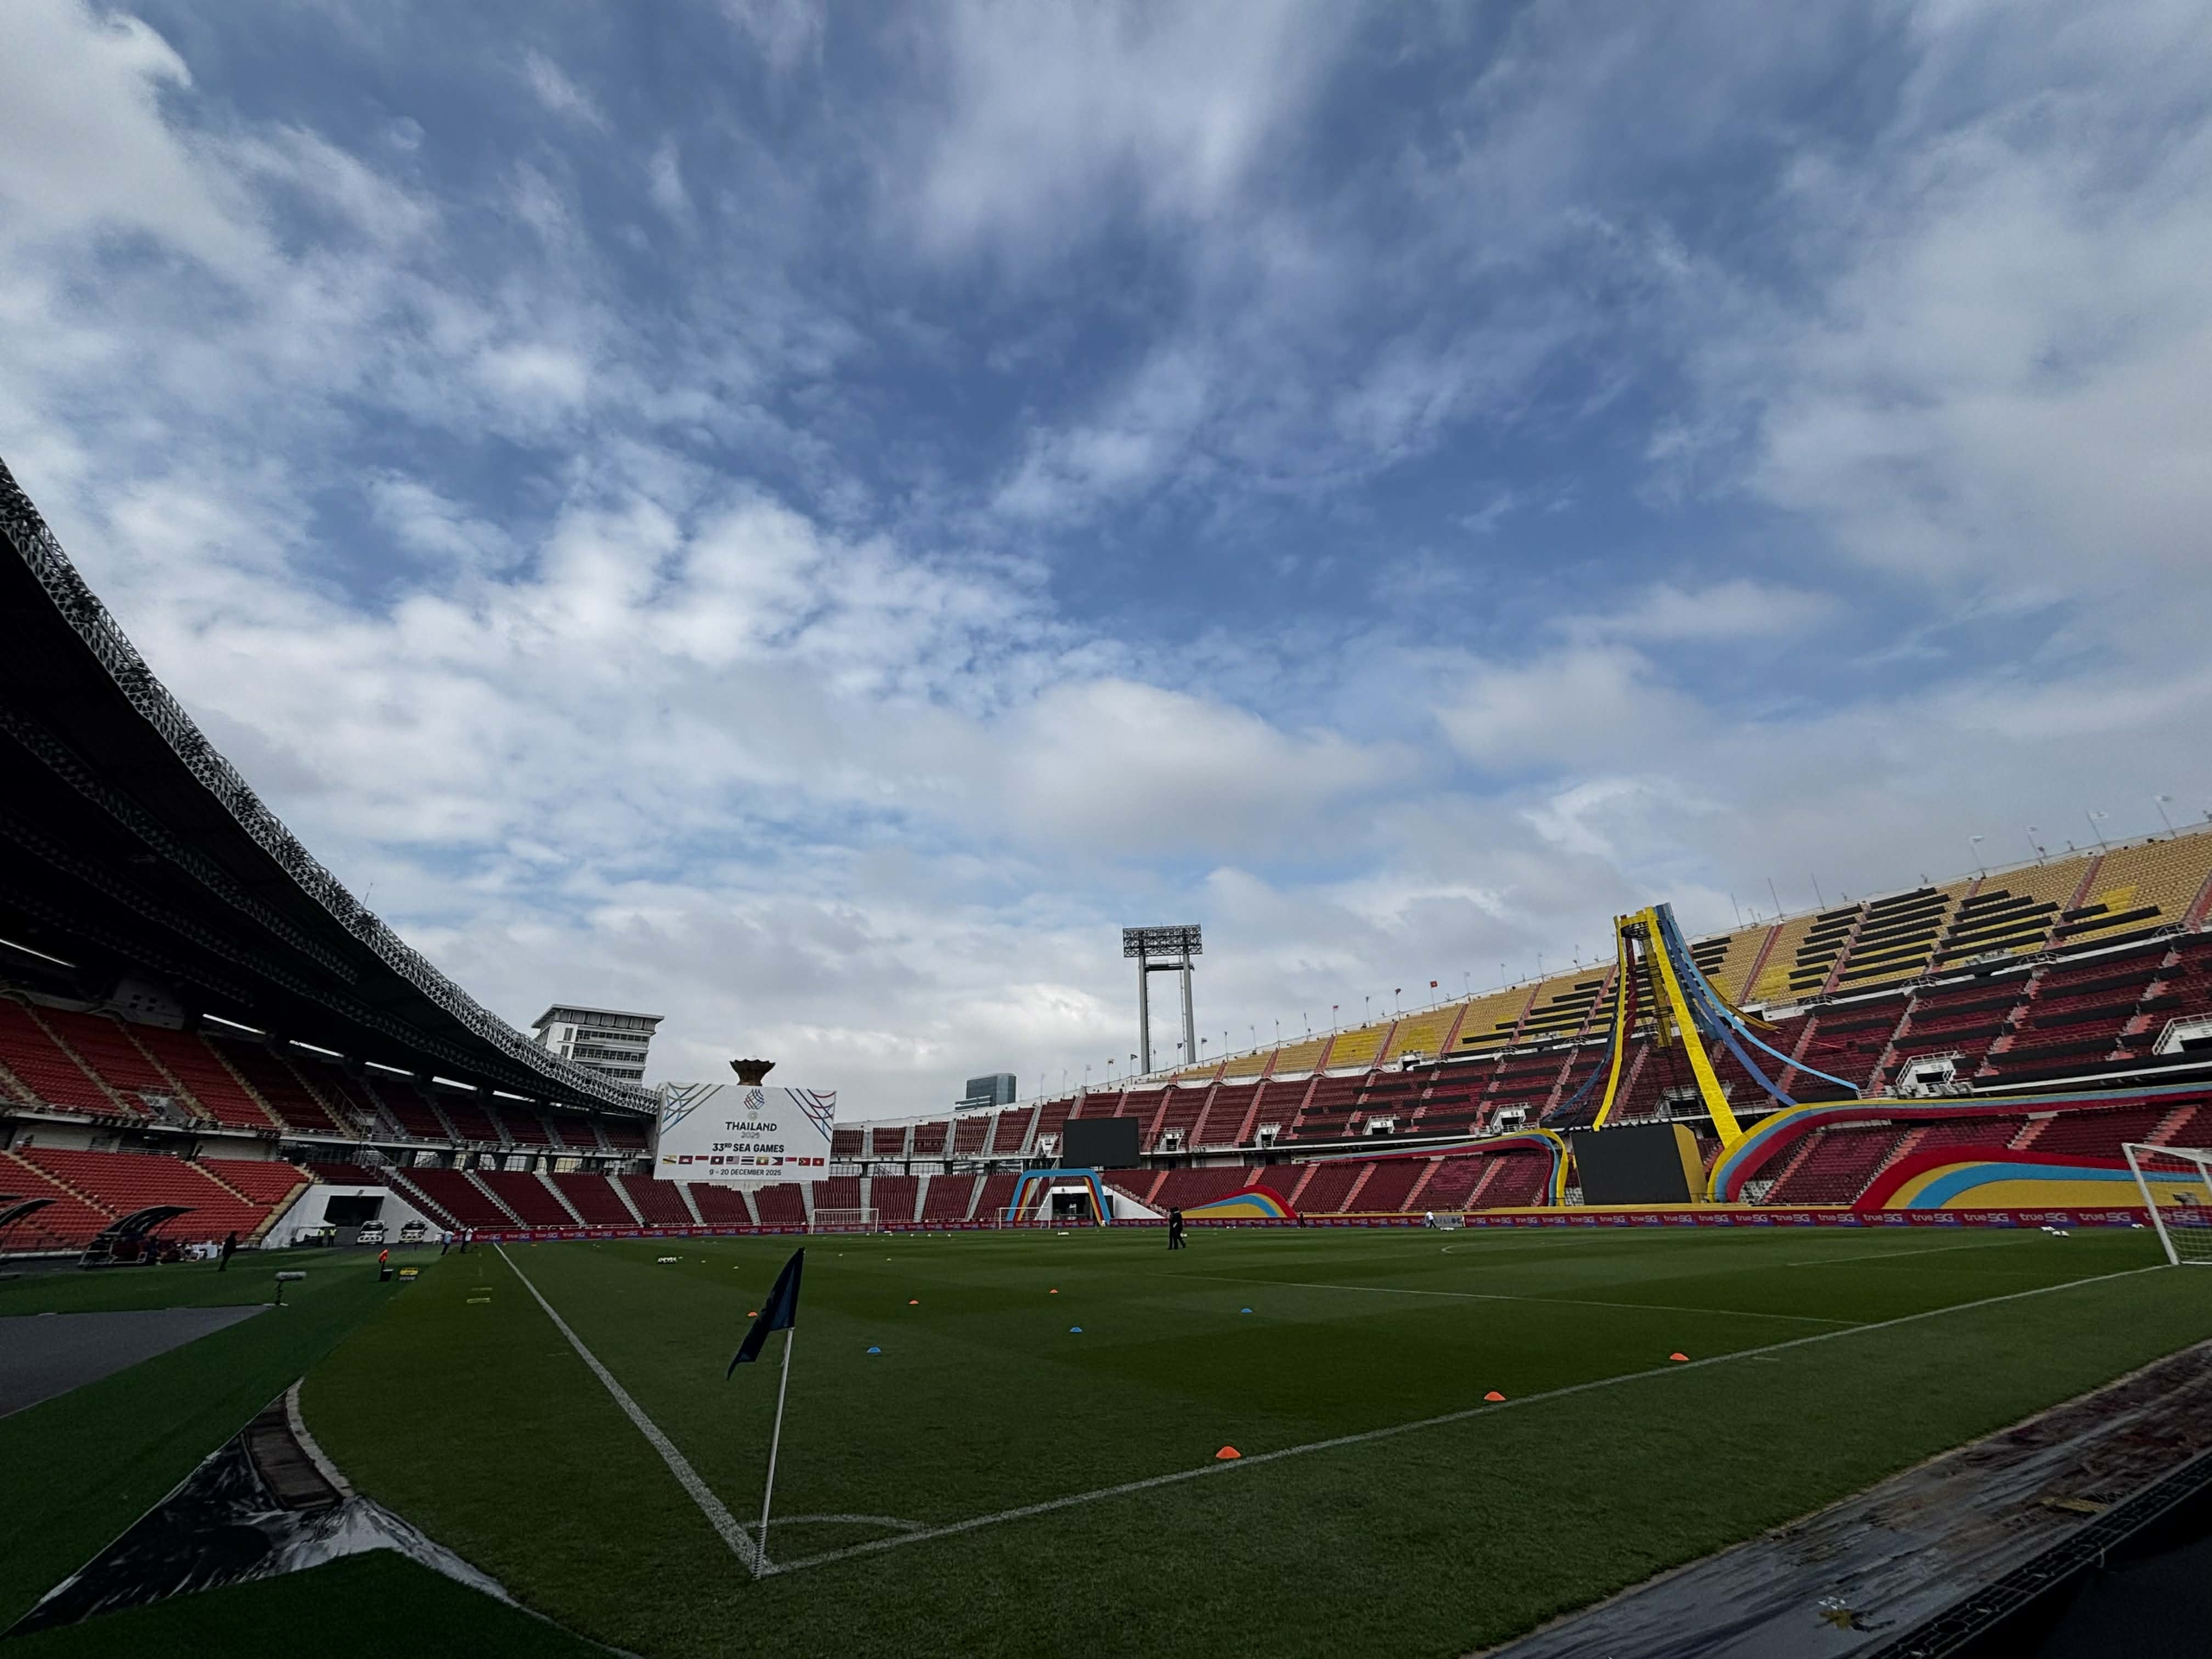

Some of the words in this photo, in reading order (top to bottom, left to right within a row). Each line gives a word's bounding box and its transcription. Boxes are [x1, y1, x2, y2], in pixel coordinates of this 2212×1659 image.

[725, 1122, 777, 1131] THAILAND
[733, 1143, 751, 1152] SEA
[753, 1144, 785, 1153] GAMES
